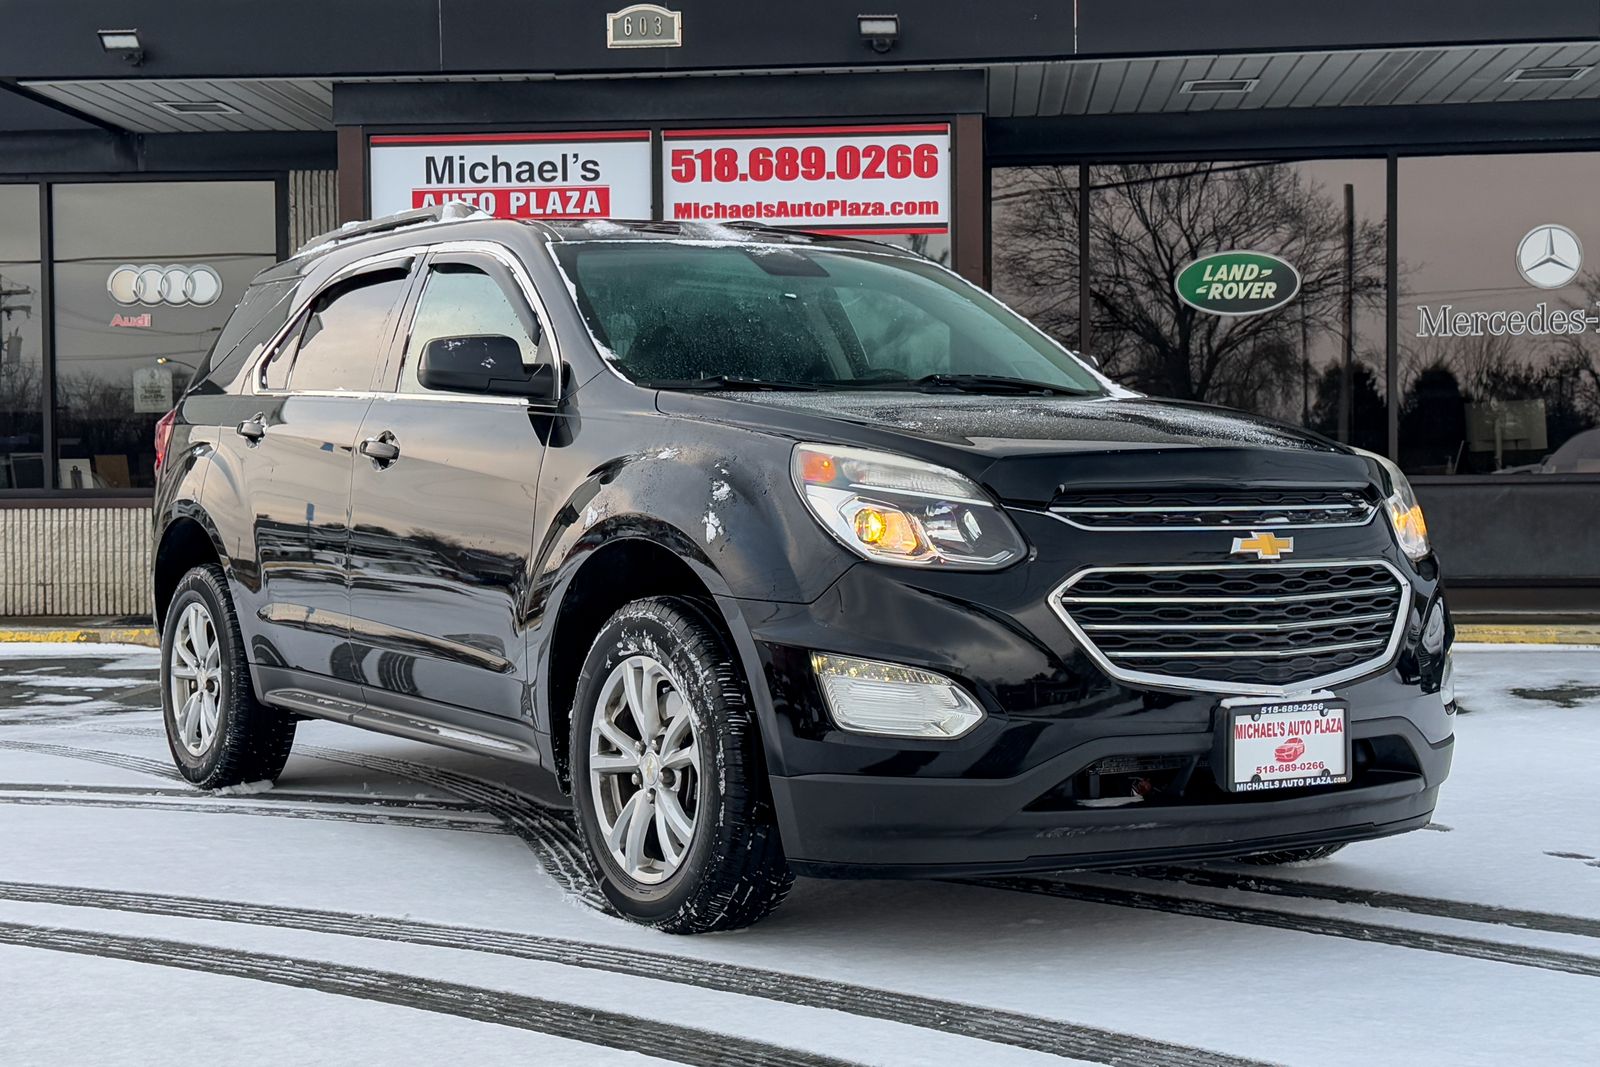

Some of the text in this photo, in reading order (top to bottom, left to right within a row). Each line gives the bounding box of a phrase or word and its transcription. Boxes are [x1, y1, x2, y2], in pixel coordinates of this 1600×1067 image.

[624, 16, 662, 36] 603
[425, 153, 600, 185] Michael's
[671, 143, 939, 183] 518.689.0266
[509, 190, 601, 215] PLAZA
[674, 199, 939, 220] MichaelsAutoPlaza.com
[1202, 264, 1260, 281] LAND
[1207, 282, 1277, 300] ROVER
[110, 313, 152, 327] Audi
[1416, 301, 1600, 338] Mercedes-
[1260, 703, 1324, 714] 518-689-0266
[1235, 718, 1343, 739] MICHAEL'S AUTO PLAZA
[1255, 761, 1325, 774] 518-689-0266
[1236, 780, 1280, 792] MICHAELS
[1281, 778, 1305, 789] AUTO
